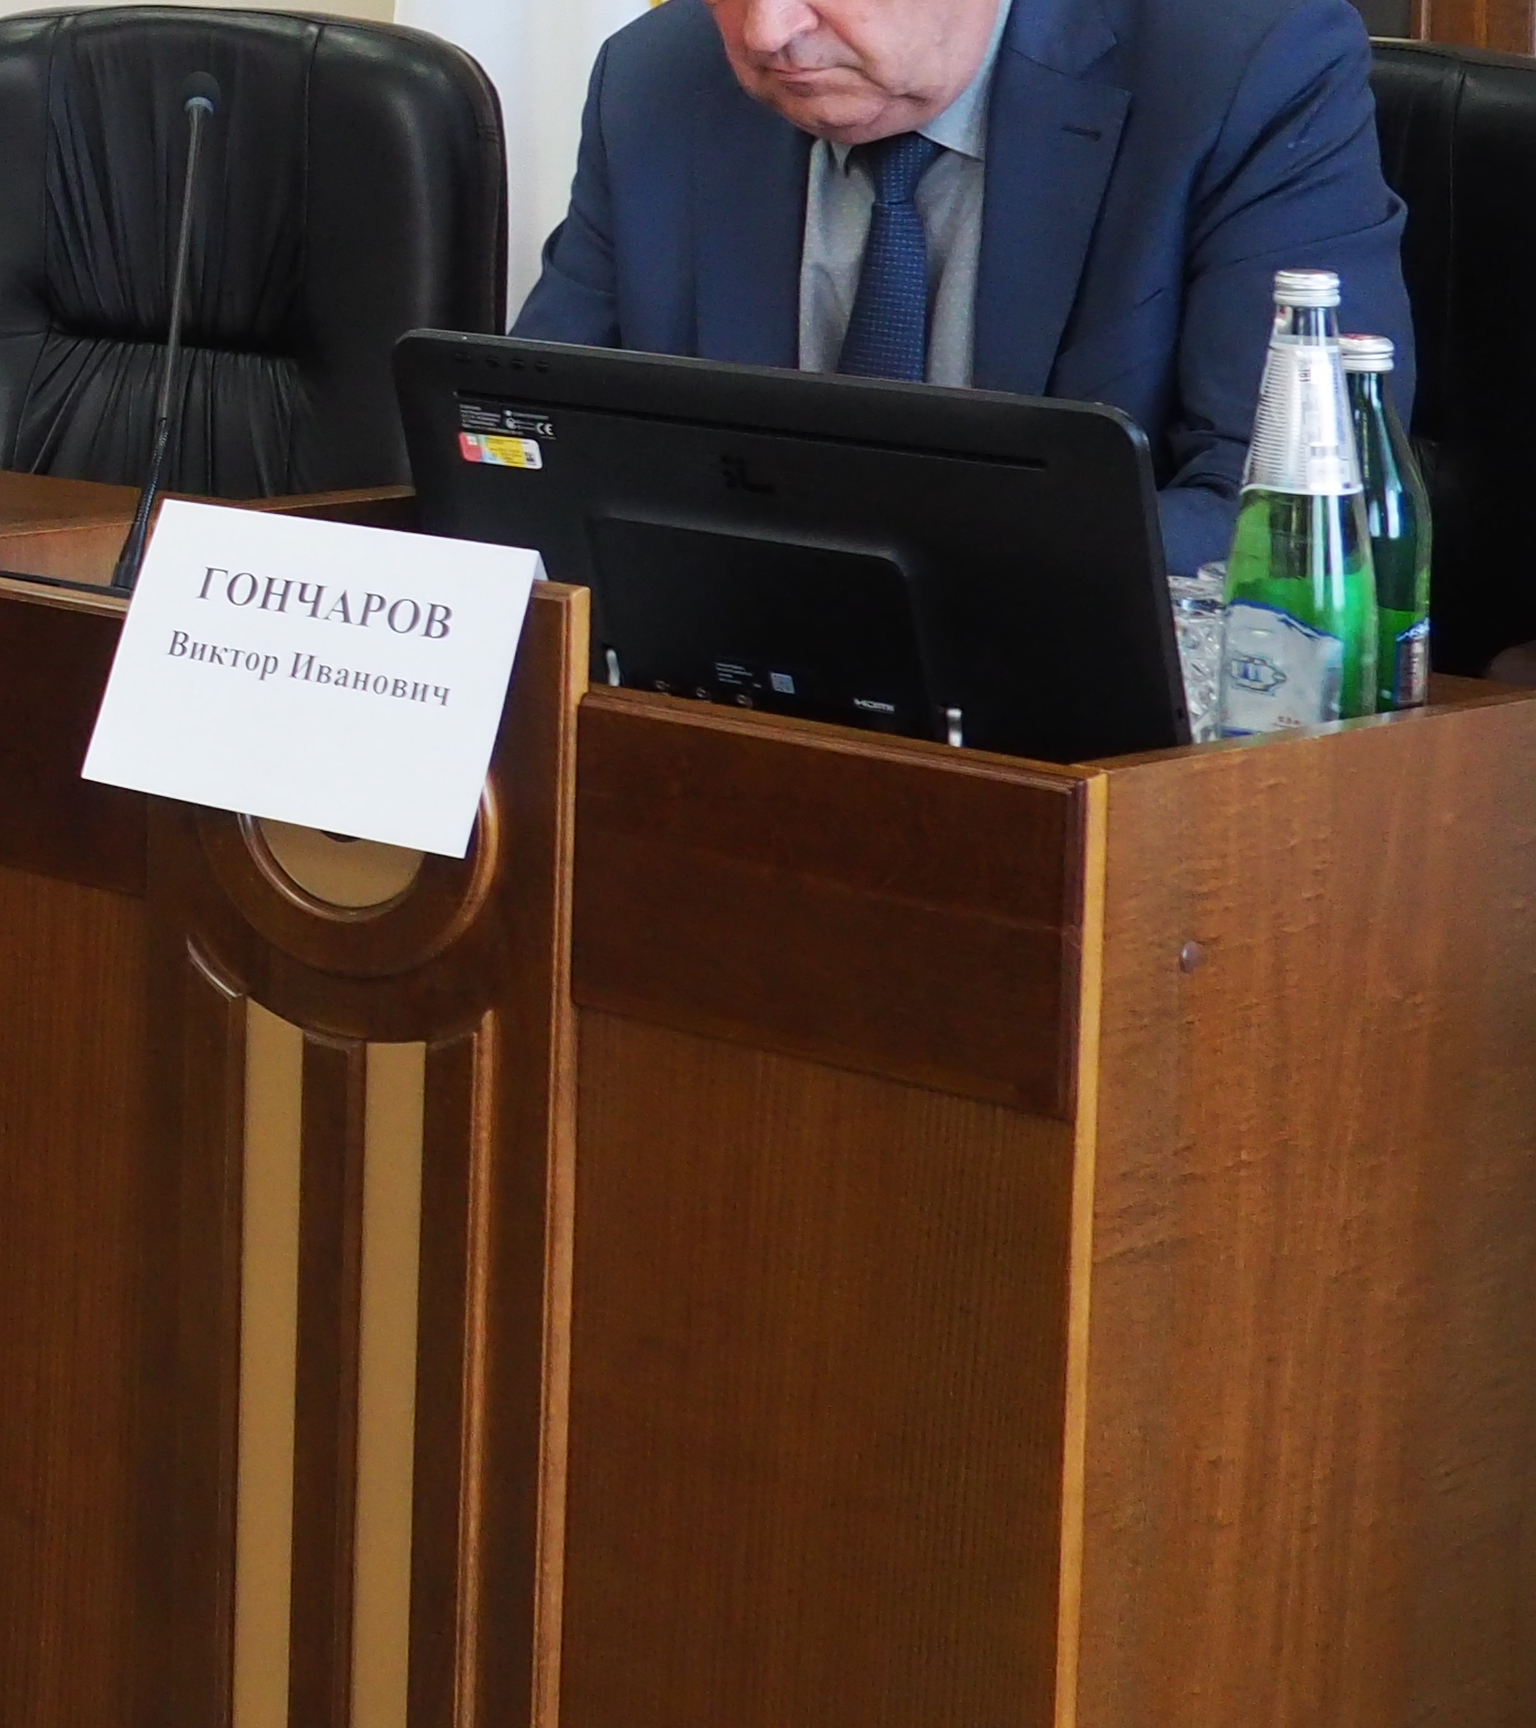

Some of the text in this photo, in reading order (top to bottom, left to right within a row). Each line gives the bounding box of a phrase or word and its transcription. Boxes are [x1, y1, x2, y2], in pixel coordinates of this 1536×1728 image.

[196, 566, 454, 640] ГОНЧАРОВ
[167, 629, 452, 708] Виктор Иванович
